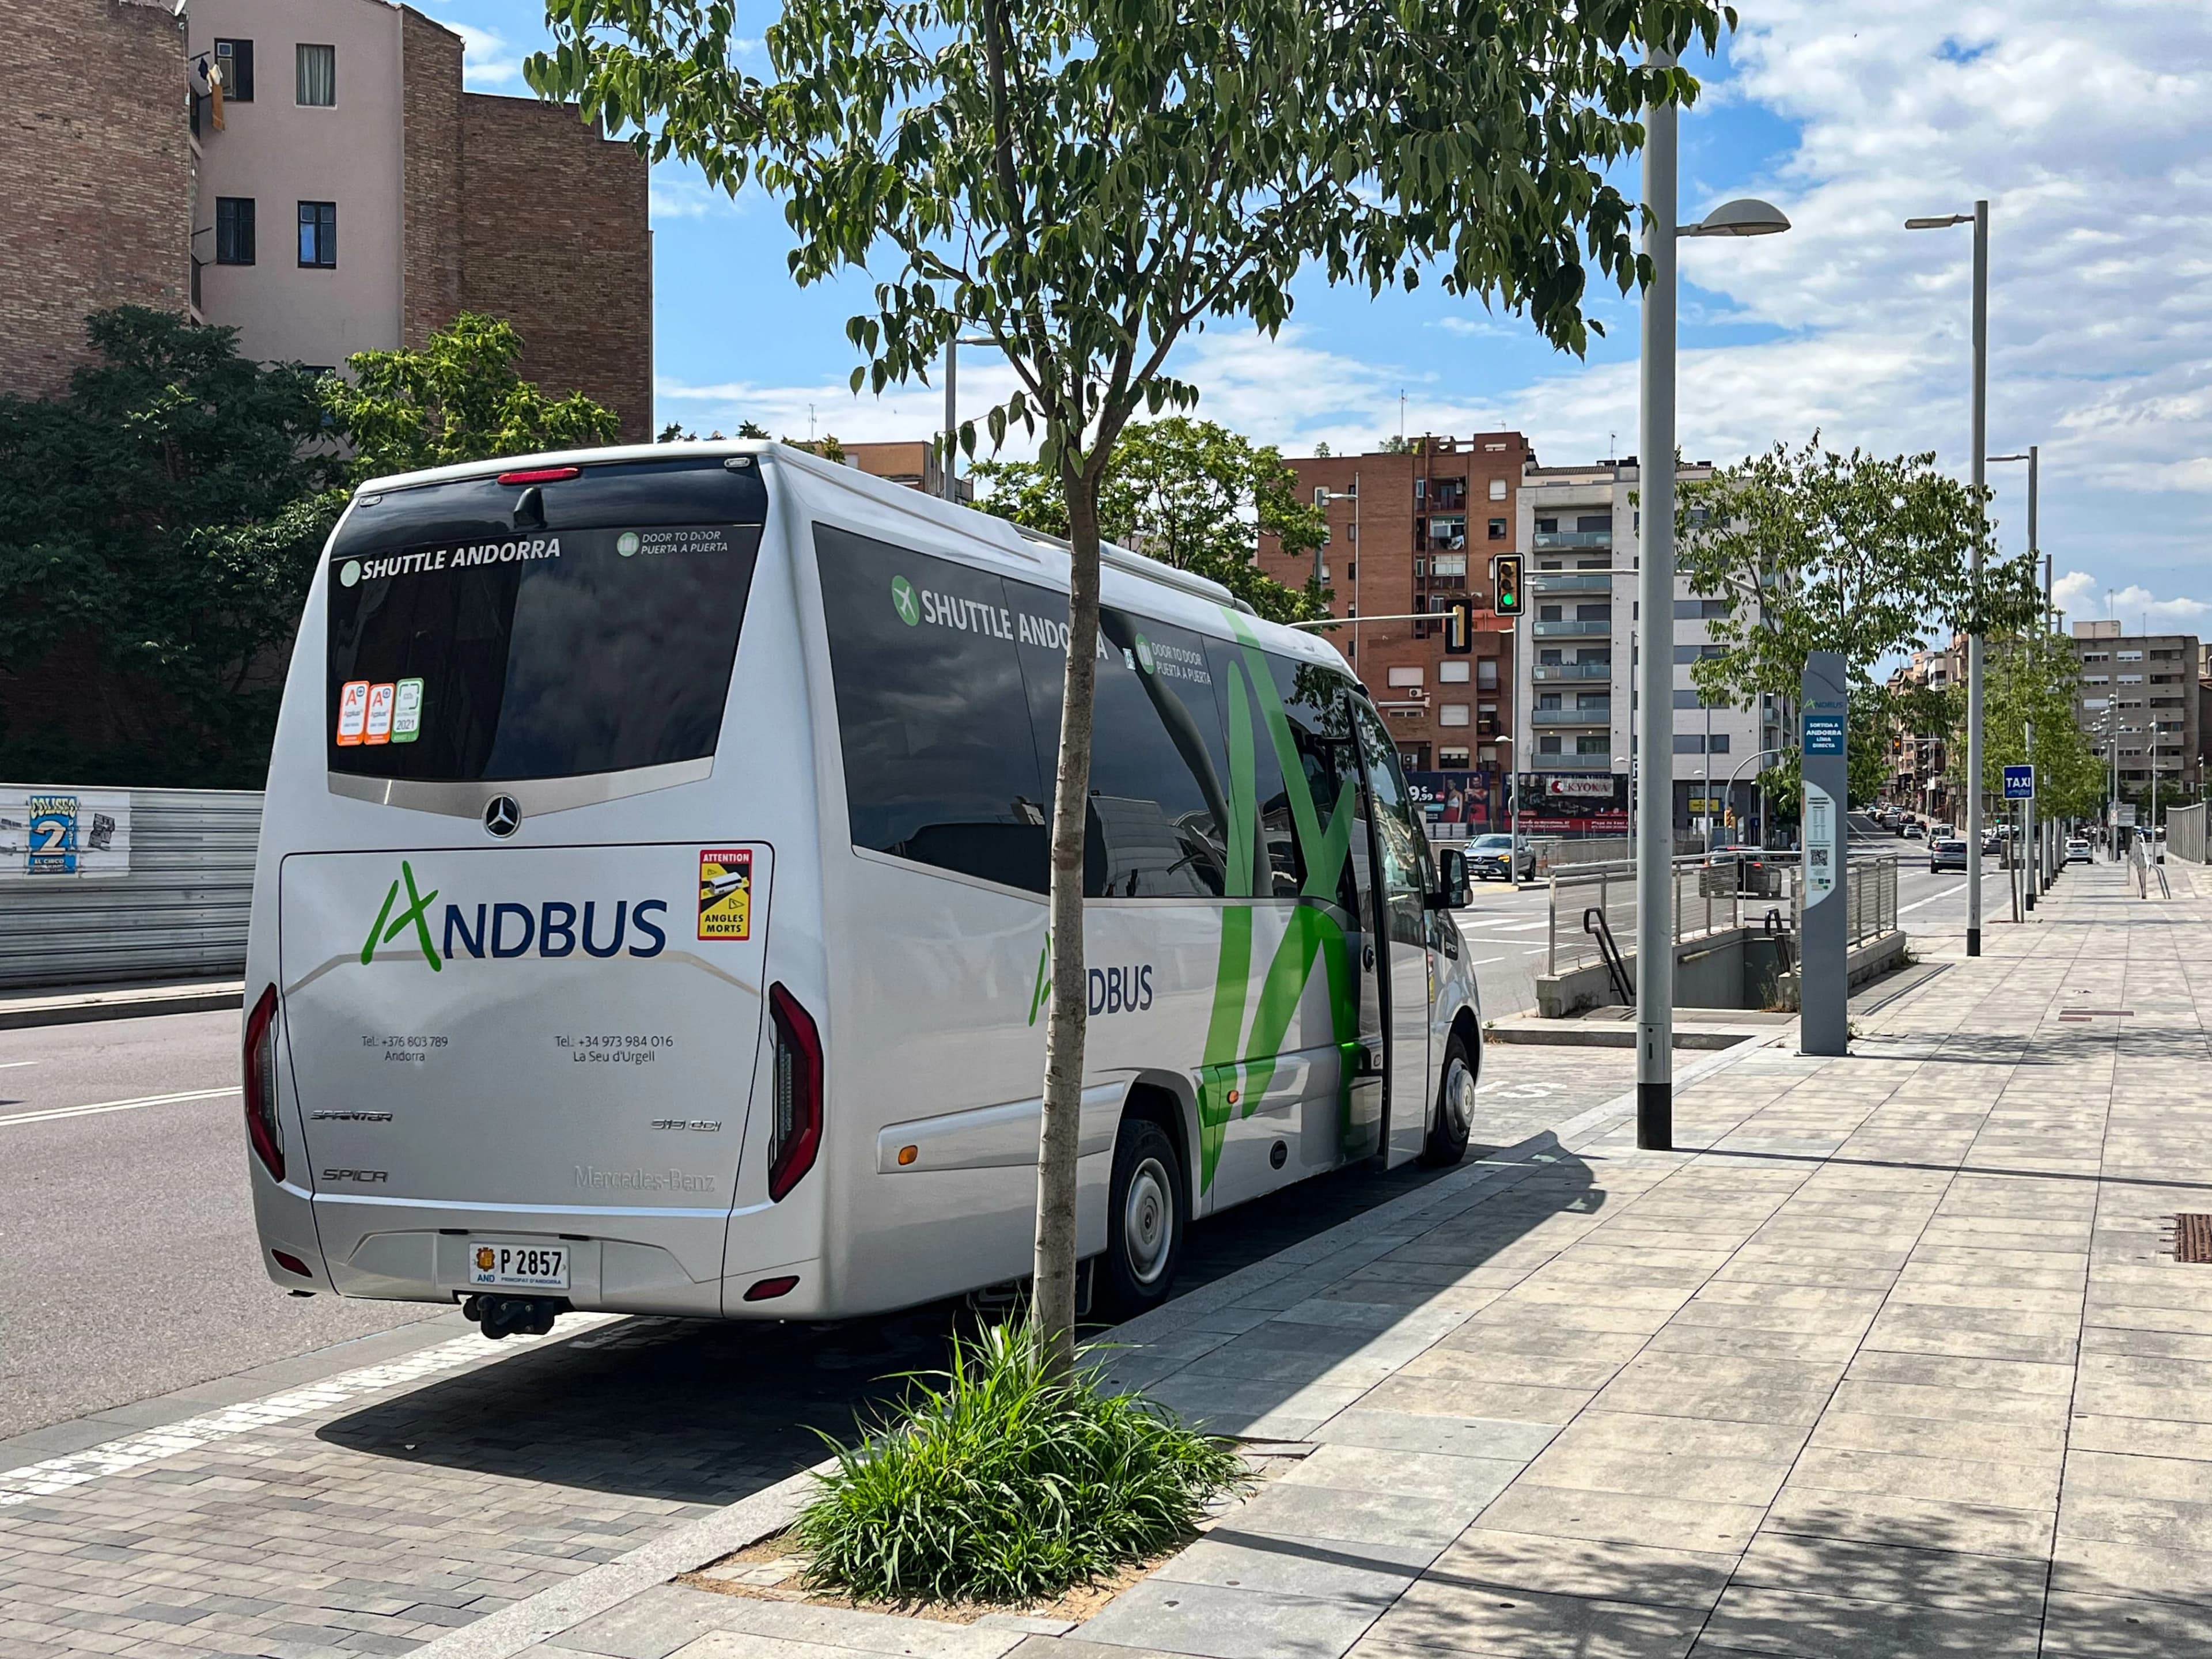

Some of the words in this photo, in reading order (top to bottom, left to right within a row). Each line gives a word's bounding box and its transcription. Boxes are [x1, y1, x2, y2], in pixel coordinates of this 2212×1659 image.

[642, 533, 672, 543] DOOR
[675, 532, 688, 541] TO
[690, 531, 721, 541] DOOR
[641, 544, 677, 554] PUERTA
[680, 544, 687, 552] A
[691, 543, 728, 552] PUERTA
[362, 550, 447, 580] SHUTTLE
[450, 539, 560, 567] ANDORRA
[921, 590, 1013, 640] SHUTTLE
[1019, 613, 1109, 660] ANDOA
[1152, 642, 1172, 659] DOOR
[1172, 647, 1183, 661] TO
[1183, 650, 1203, 666] DOOR
[1157, 661, 1181, 678] PUERTA
[1183, 667, 1188, 680] A
[1188, 668, 1211, 685] PUERTA
[396, 719, 414, 730] 2021
[1569, 783, 1608, 792] KYOKA
[2006, 778, 2031, 787] TAXI
[31, 798, 77, 819] COLISEO
[33, 820, 66, 855] 2
[703, 854, 749, 862] ATTENTION
[361, 860, 667, 972] ANDBUS
[706, 925, 741, 933] MORTS
[381, 1036, 404, 1047] +376
[408, 1036, 427, 1047] 803
[430, 1036, 448, 1047] 789
[579, 1036, 599, 1047] +34
[602, 1036, 622, 1047] 973
[626, 1036, 647, 1047] 984
[651, 1036, 673, 1047] 016
[385, 1051, 425, 1061] Andorra
[574, 1051, 586, 1062] La
[589, 1051, 609, 1062] Seu
[612, 1050, 654, 1065] d'Urgell
[310, 1110, 393, 1122] SPRINTER
[689, 1120, 722, 1132] CDI
[321, 1168, 388, 1182] SPICA
[574, 1165, 715, 1192] Mercedes-Benz
[501, 1249, 510, 1273] P
[517, 1250, 562, 1276] 2857
[477, 1274, 495, 1282] AND
